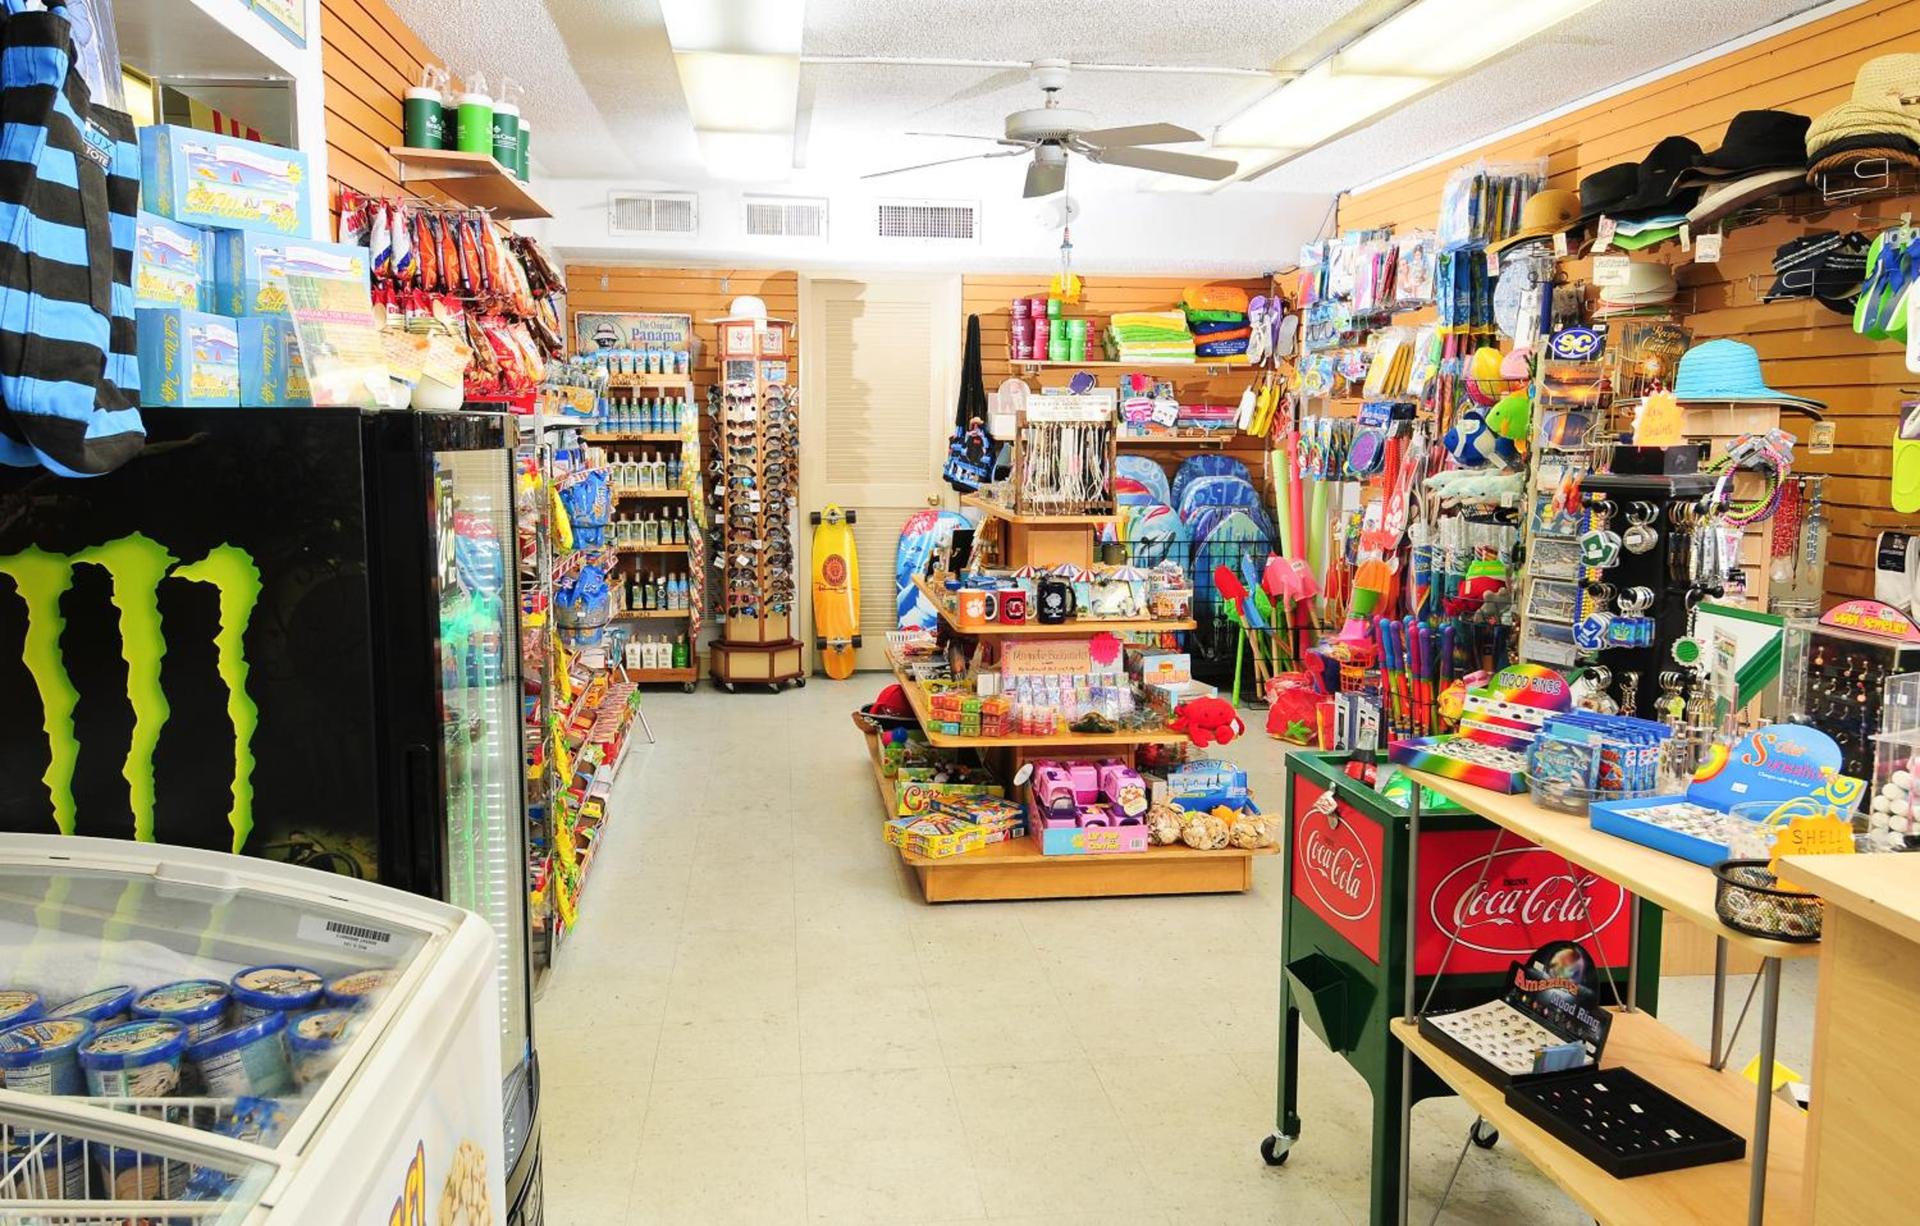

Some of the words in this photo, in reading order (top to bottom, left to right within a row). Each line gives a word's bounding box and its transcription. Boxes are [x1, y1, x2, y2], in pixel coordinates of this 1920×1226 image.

[84, 131, 113, 154] LUX
[85, 145, 110, 168] TOTE
[631, 326, 682, 342] Panama
[1557, 333, 1593, 353] SC
[1499, 671, 1530, 689] MOOD
[1531, 677, 1561, 696] RINGS
[1792, 828, 1842, 845] SHELL
[1305, 829, 1366, 900] Coca-Cola
[1453, 873, 1599, 929] Coca-Cola
[1514, 968, 1580, 997] Amazing
[1550, 991, 1578, 1017] Mood
[1576, 1006, 1601, 1033] Ring
